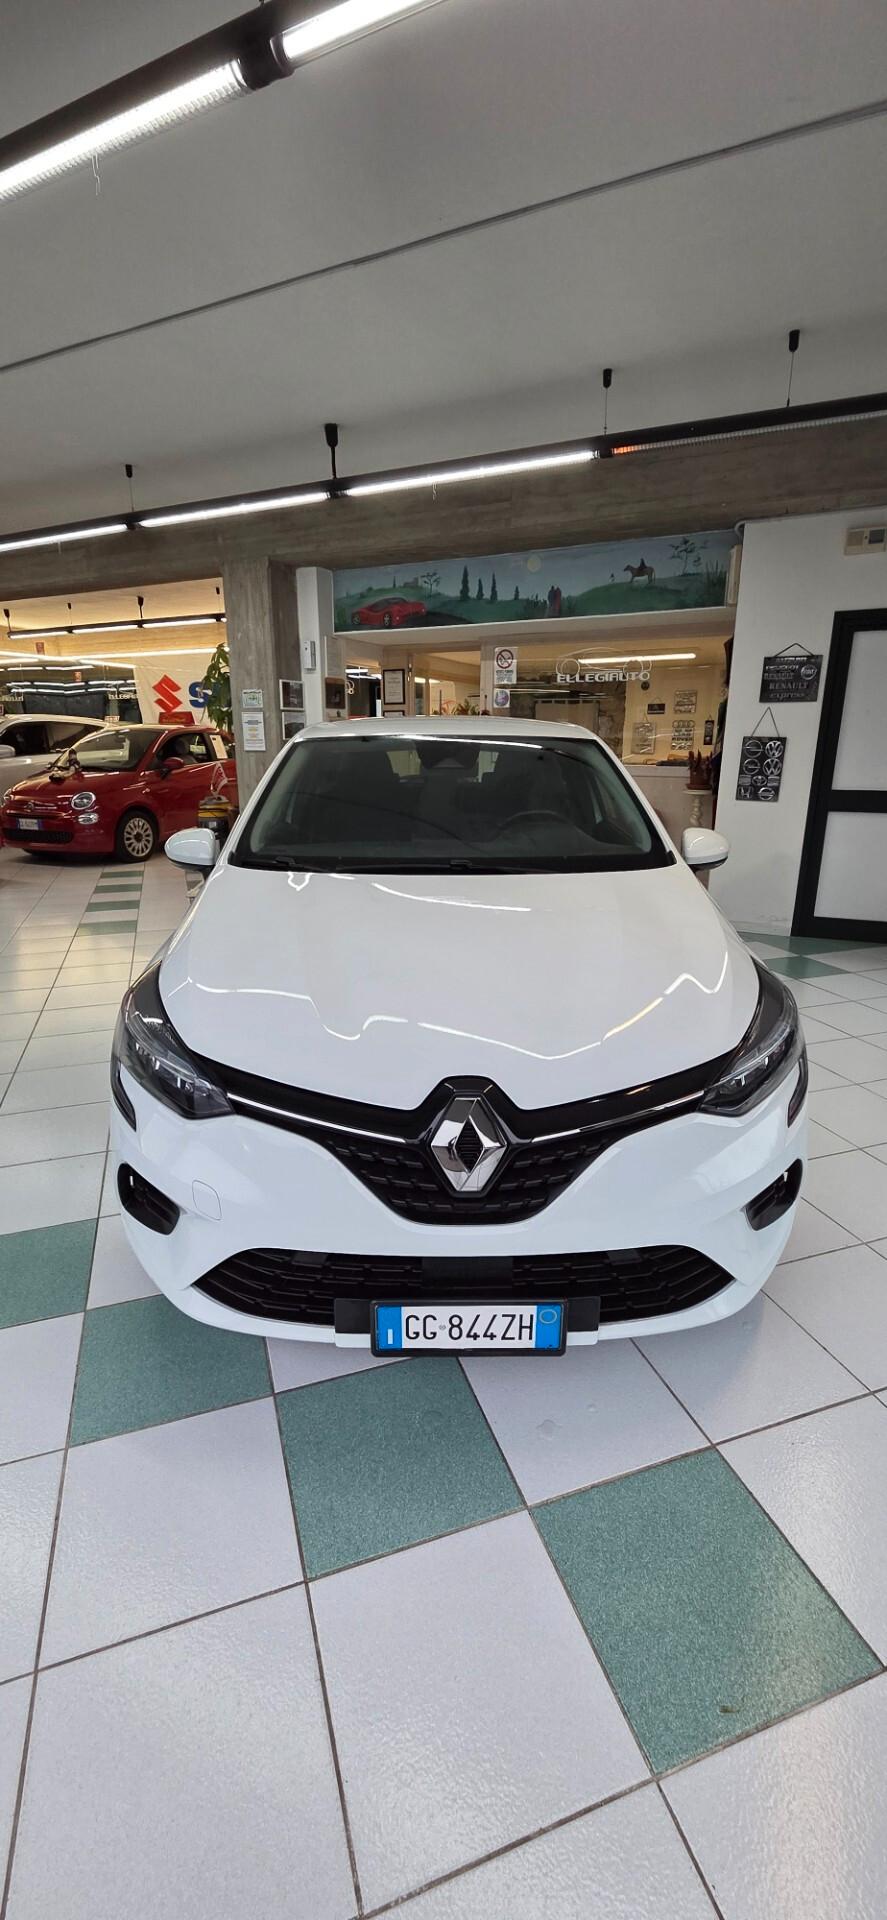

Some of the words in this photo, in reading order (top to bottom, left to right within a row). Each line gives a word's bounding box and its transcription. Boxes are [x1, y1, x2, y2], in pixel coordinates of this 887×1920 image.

[556, 671, 650, 683] ELLEGIAUTO
[769, 681, 809, 689] RENAULT
[405, 1314, 437, 1340] GG
[448, 1314, 534, 1341] 844ZH
